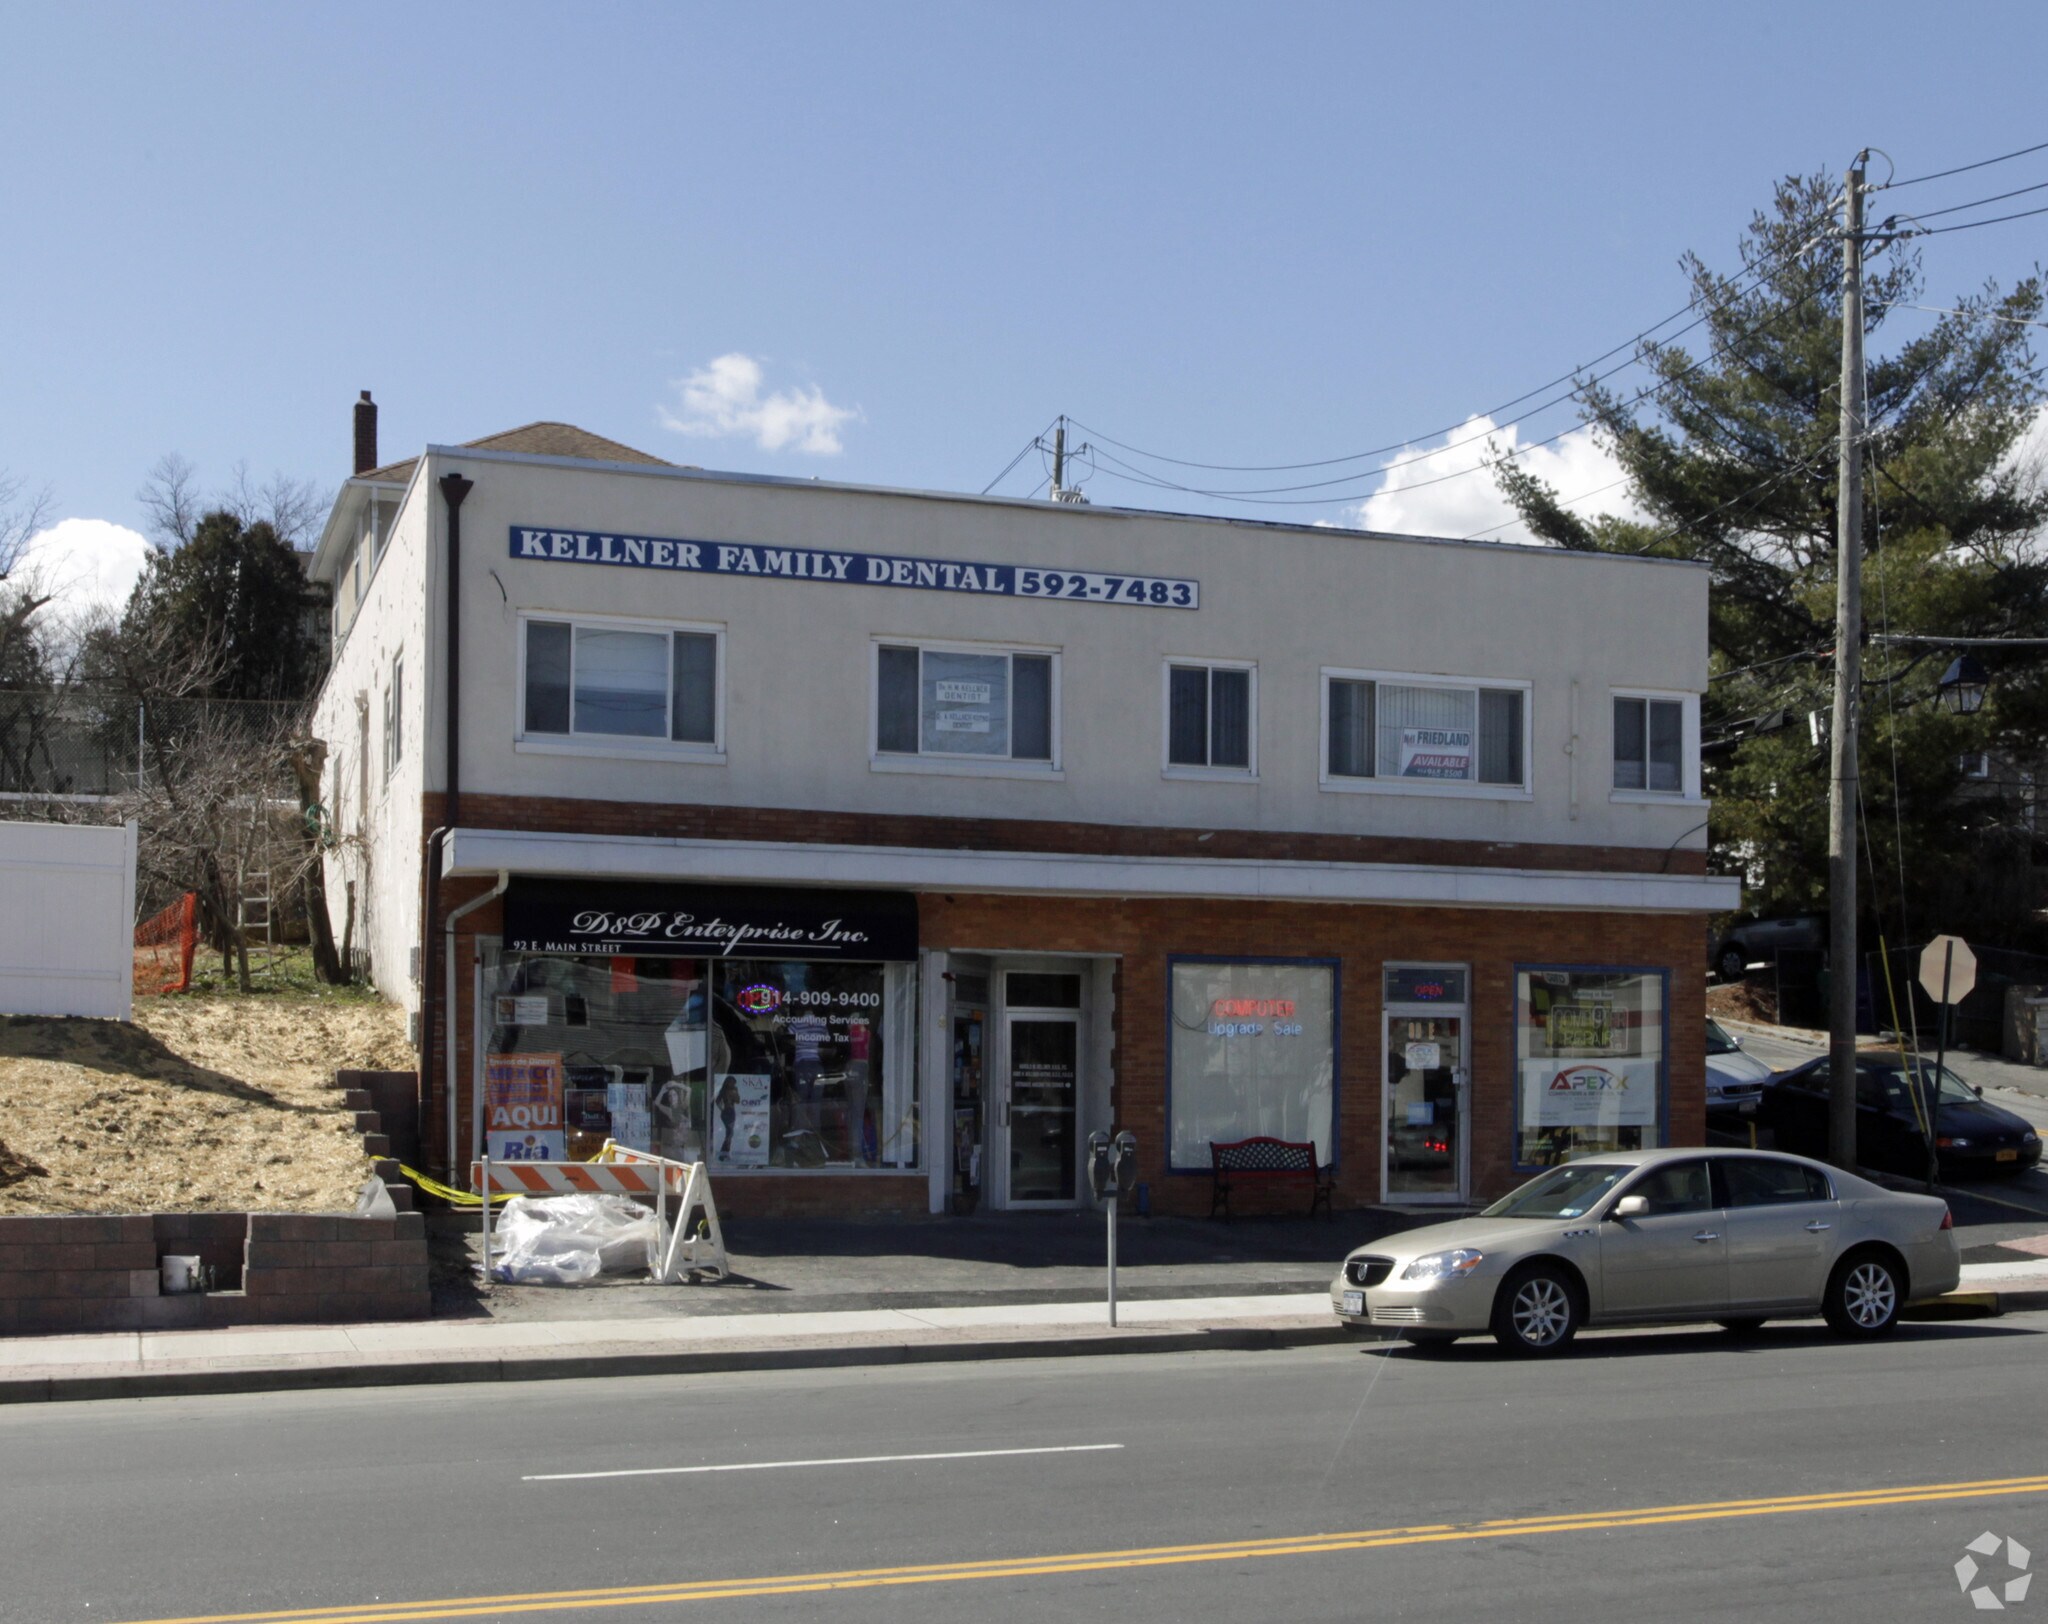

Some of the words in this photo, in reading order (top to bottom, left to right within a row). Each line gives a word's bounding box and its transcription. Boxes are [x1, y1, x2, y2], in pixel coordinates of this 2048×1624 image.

[520, 531, 702, 568] KELLNER
[717, 545, 853, 579] FAMILY
[866, 557, 1005, 593] DENTAL
[1021, 572, 1192, 606] 592-7483
[944, 691, 982, 700] DENTIST
[1417, 731, 1470, 747] FRIEDLAND
[1413, 755, 1468, 768] AVAILABLE
[664, 911, 804, 956] Enterprise
[808, 919, 869, 942] Inc.
[513, 940, 527, 951] 92
[531, 941, 542, 951] E.
[1414, 985, 1445, 995] OPEN
[760, 991, 881, 1007] 914-909-9400
[1215, 999, 1296, 1017] COMPUTER
[773, 1014, 828, 1025] Accounting
[829, 1015, 870, 1025] Services
[1208, 1020, 1264, 1038] Upgrade
[1273, 1021, 1303, 1035] Sale
[795, 1033, 831, 1042] Income
[833, 1033, 850, 1042] Tax
[1563, 1030, 1615, 1048] REPAIR
[528, 1057, 557, 1065] Dinero
[742, 1077, 763, 1088] SKA
[1549, 1071, 1630, 1090] APEXX
[492, 1105, 559, 1130] AQUI
[503, 1135, 549, 1160] Ria
